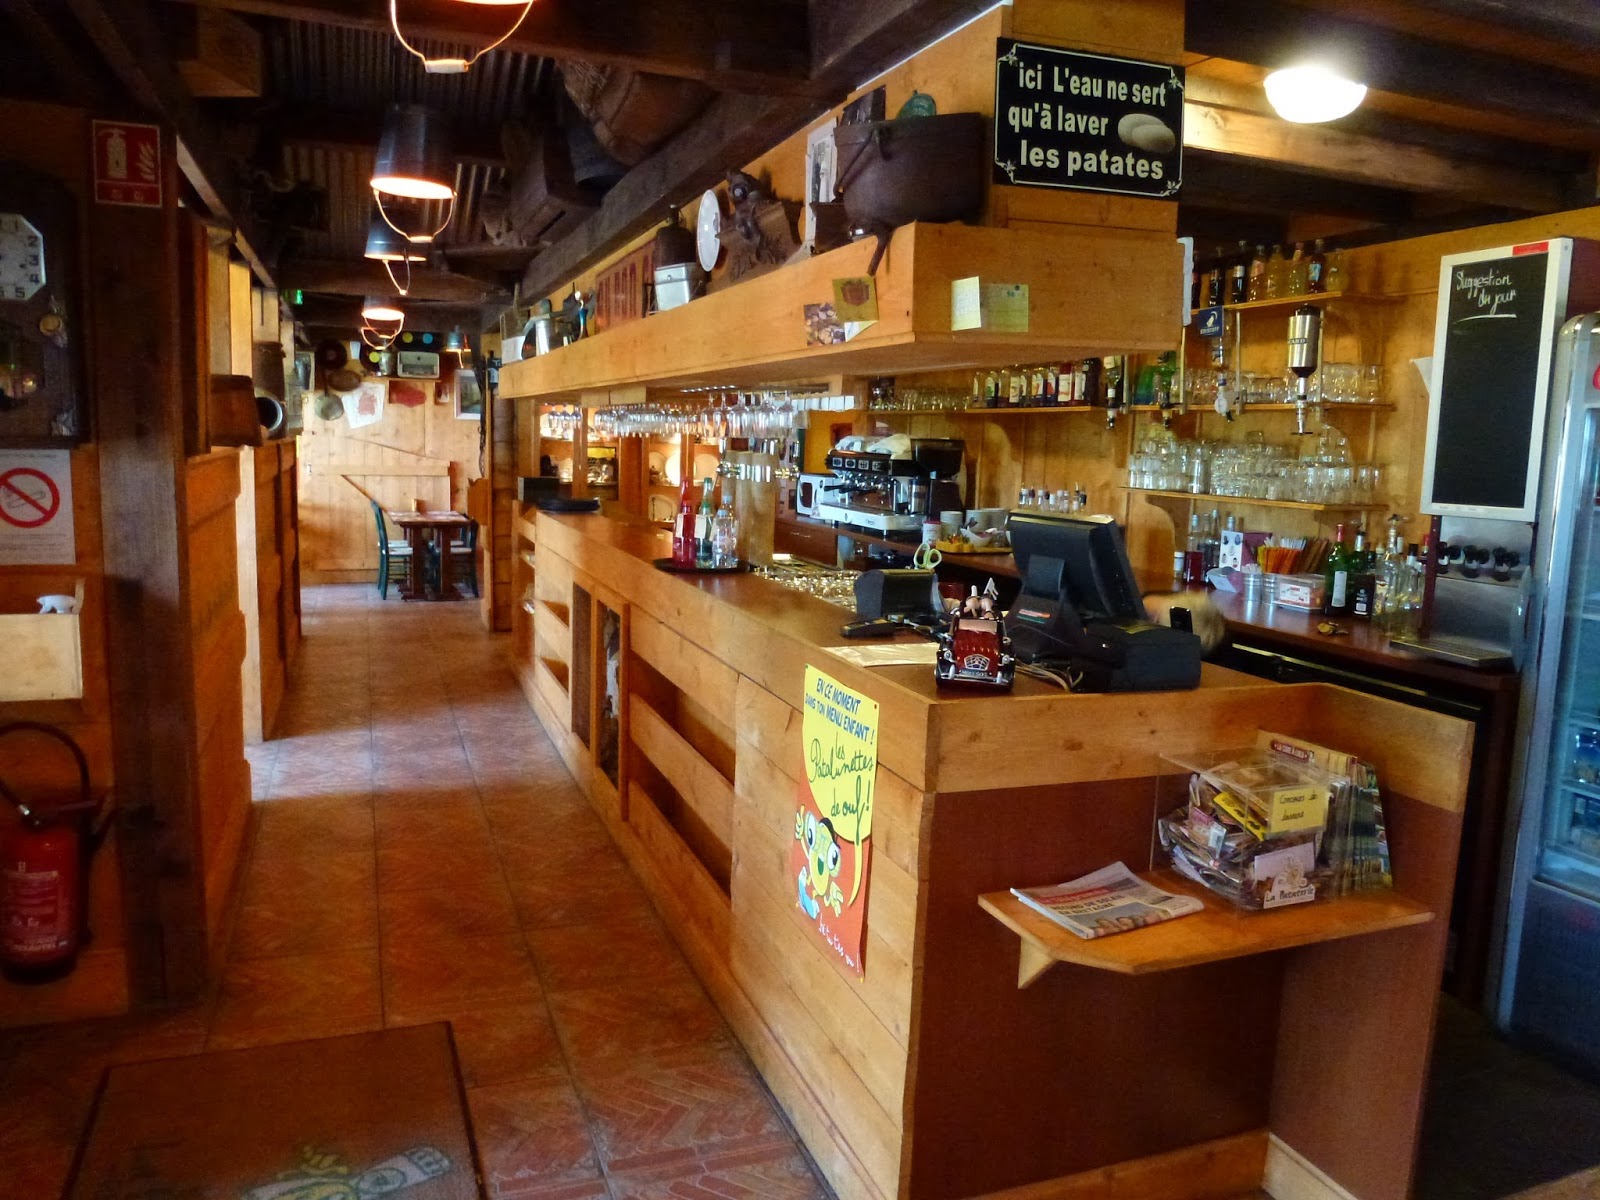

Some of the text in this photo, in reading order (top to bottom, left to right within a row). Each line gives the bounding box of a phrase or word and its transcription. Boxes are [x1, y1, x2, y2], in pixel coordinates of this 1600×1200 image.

[1019, 62, 1166, 107] ici L'eau ne sert
[1008, 102, 1109, 136] qu'à laver
[1020, 139, 1163, 180] les patates
[1456, 268, 1513, 299] Suggestion
[1478, 288, 1517, 316] du jour
[816, 677, 861, 715] EN CE MOMENT
[805, 692, 816, 710] DANS
[816, 700, 826, 716] TON
[825, 704, 844, 728] MENU
[843, 715, 870, 742] ENFANT
[835, 731, 846, 760] les
[831, 787, 841, 817] de
